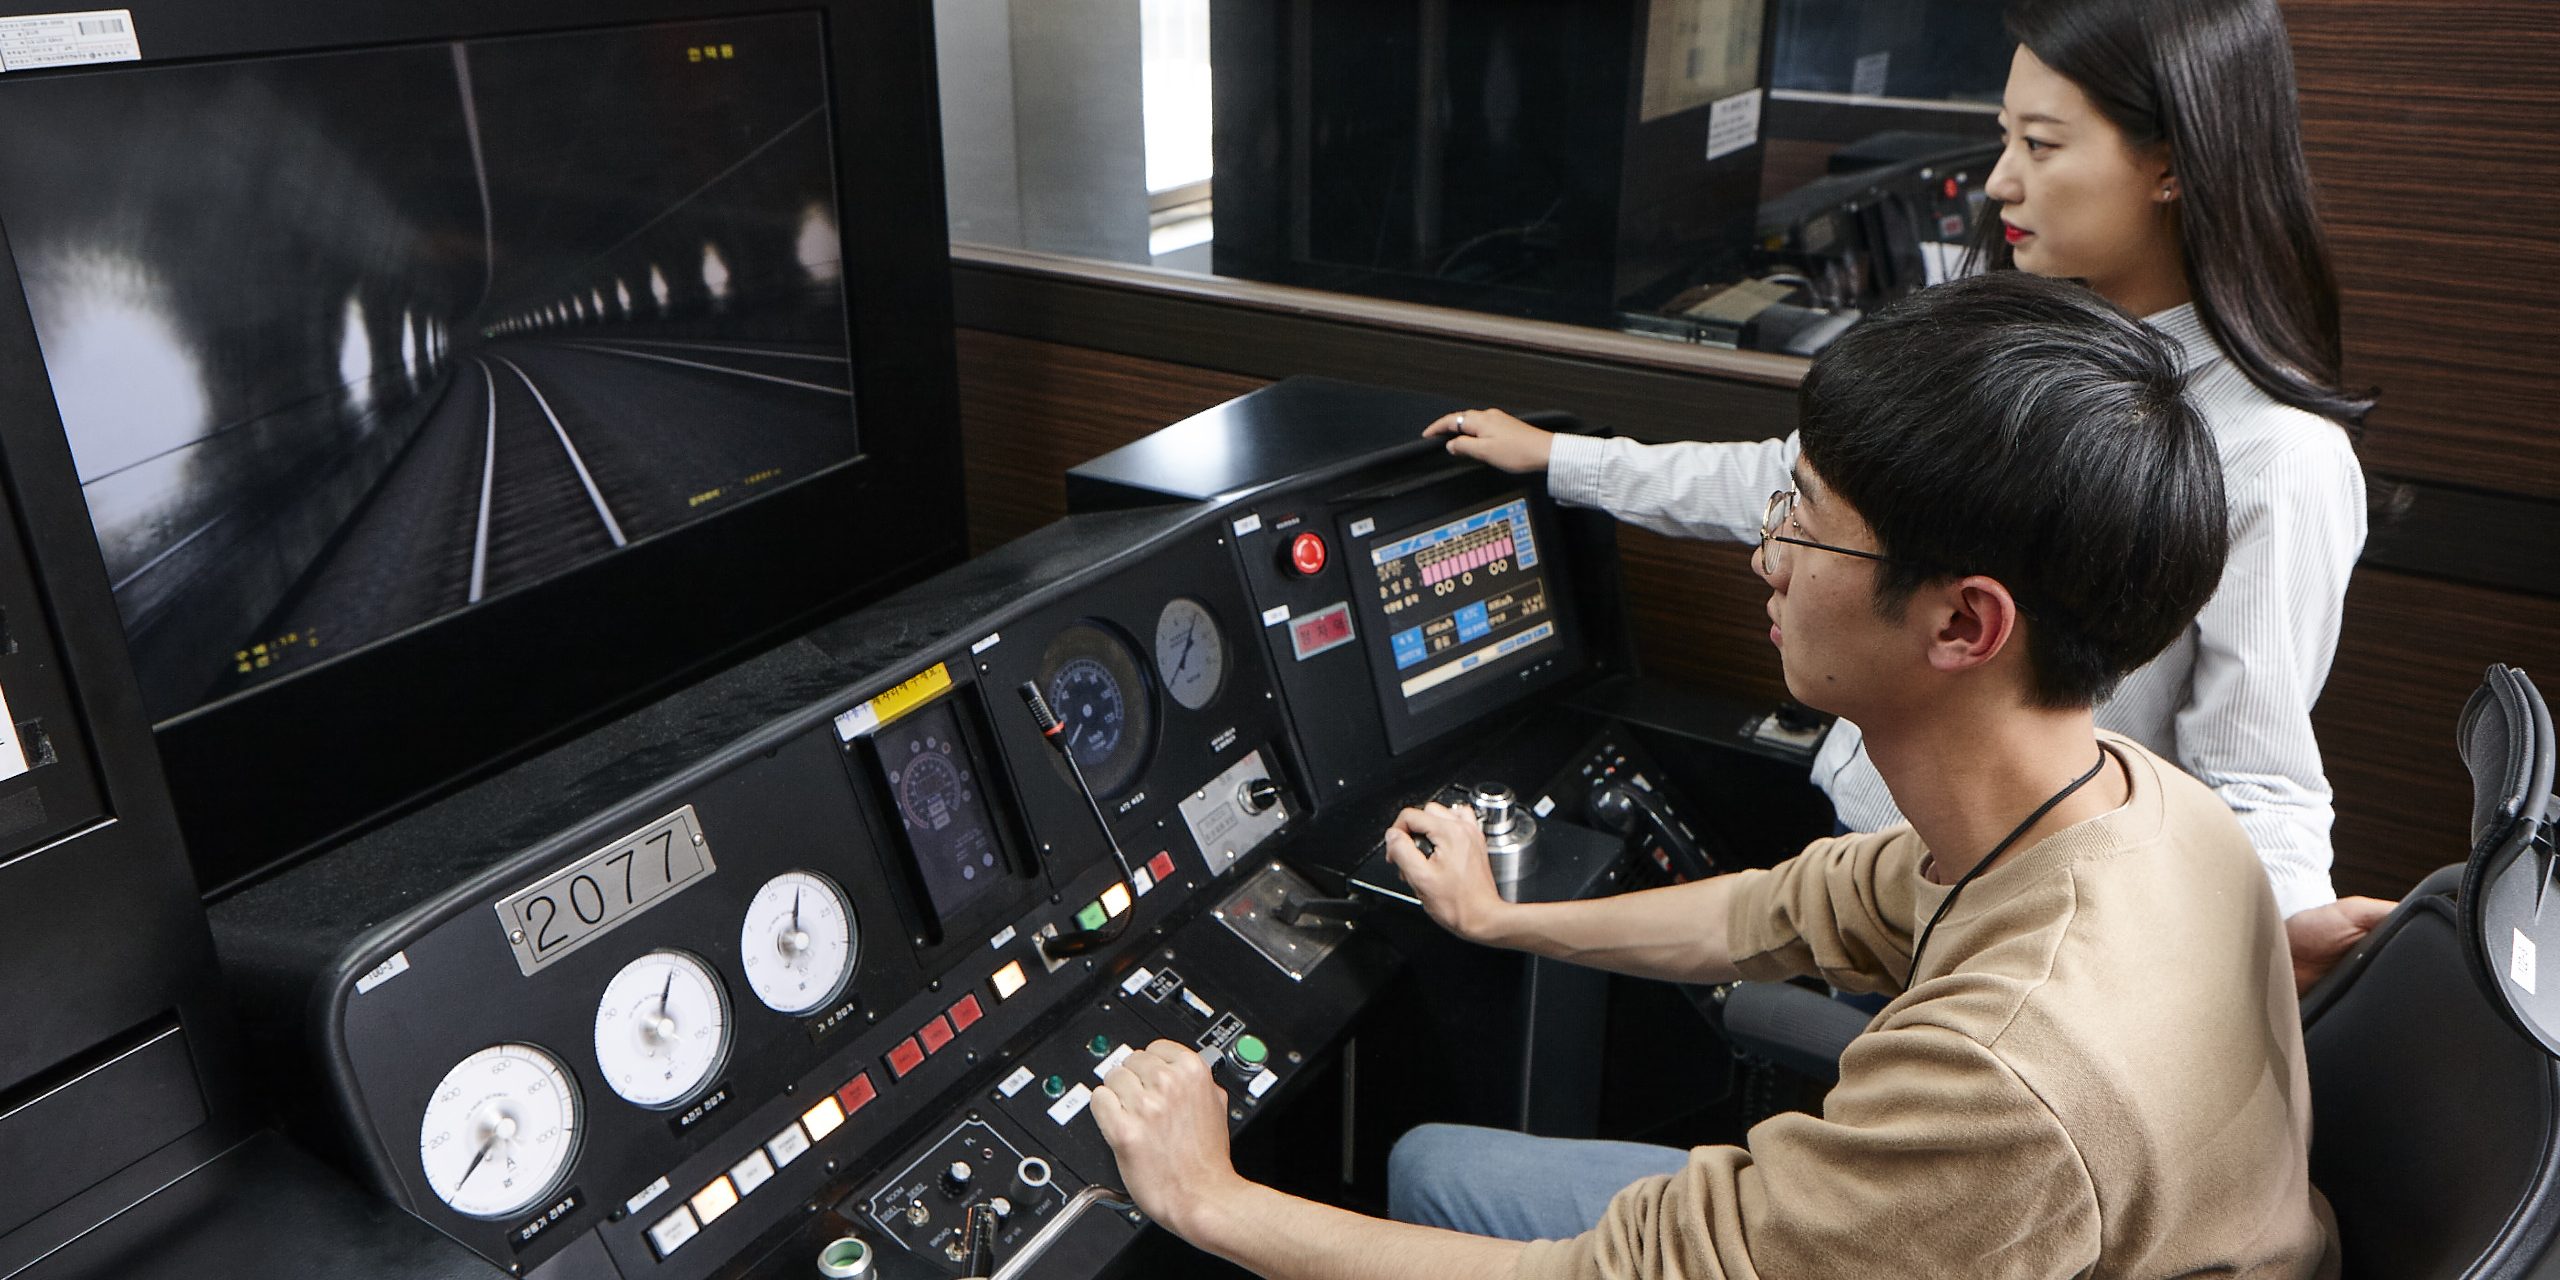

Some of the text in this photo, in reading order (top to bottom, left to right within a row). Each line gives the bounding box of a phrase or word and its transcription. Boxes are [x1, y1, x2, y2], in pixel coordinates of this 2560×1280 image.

[526, 829, 673, 953] 2077
[492, 1059, 512, 1074] 600
[441, 1087, 461, 1103] 400
[430, 1131, 450, 1150] 200
[885, 1186, 905, 1204] ROOM
